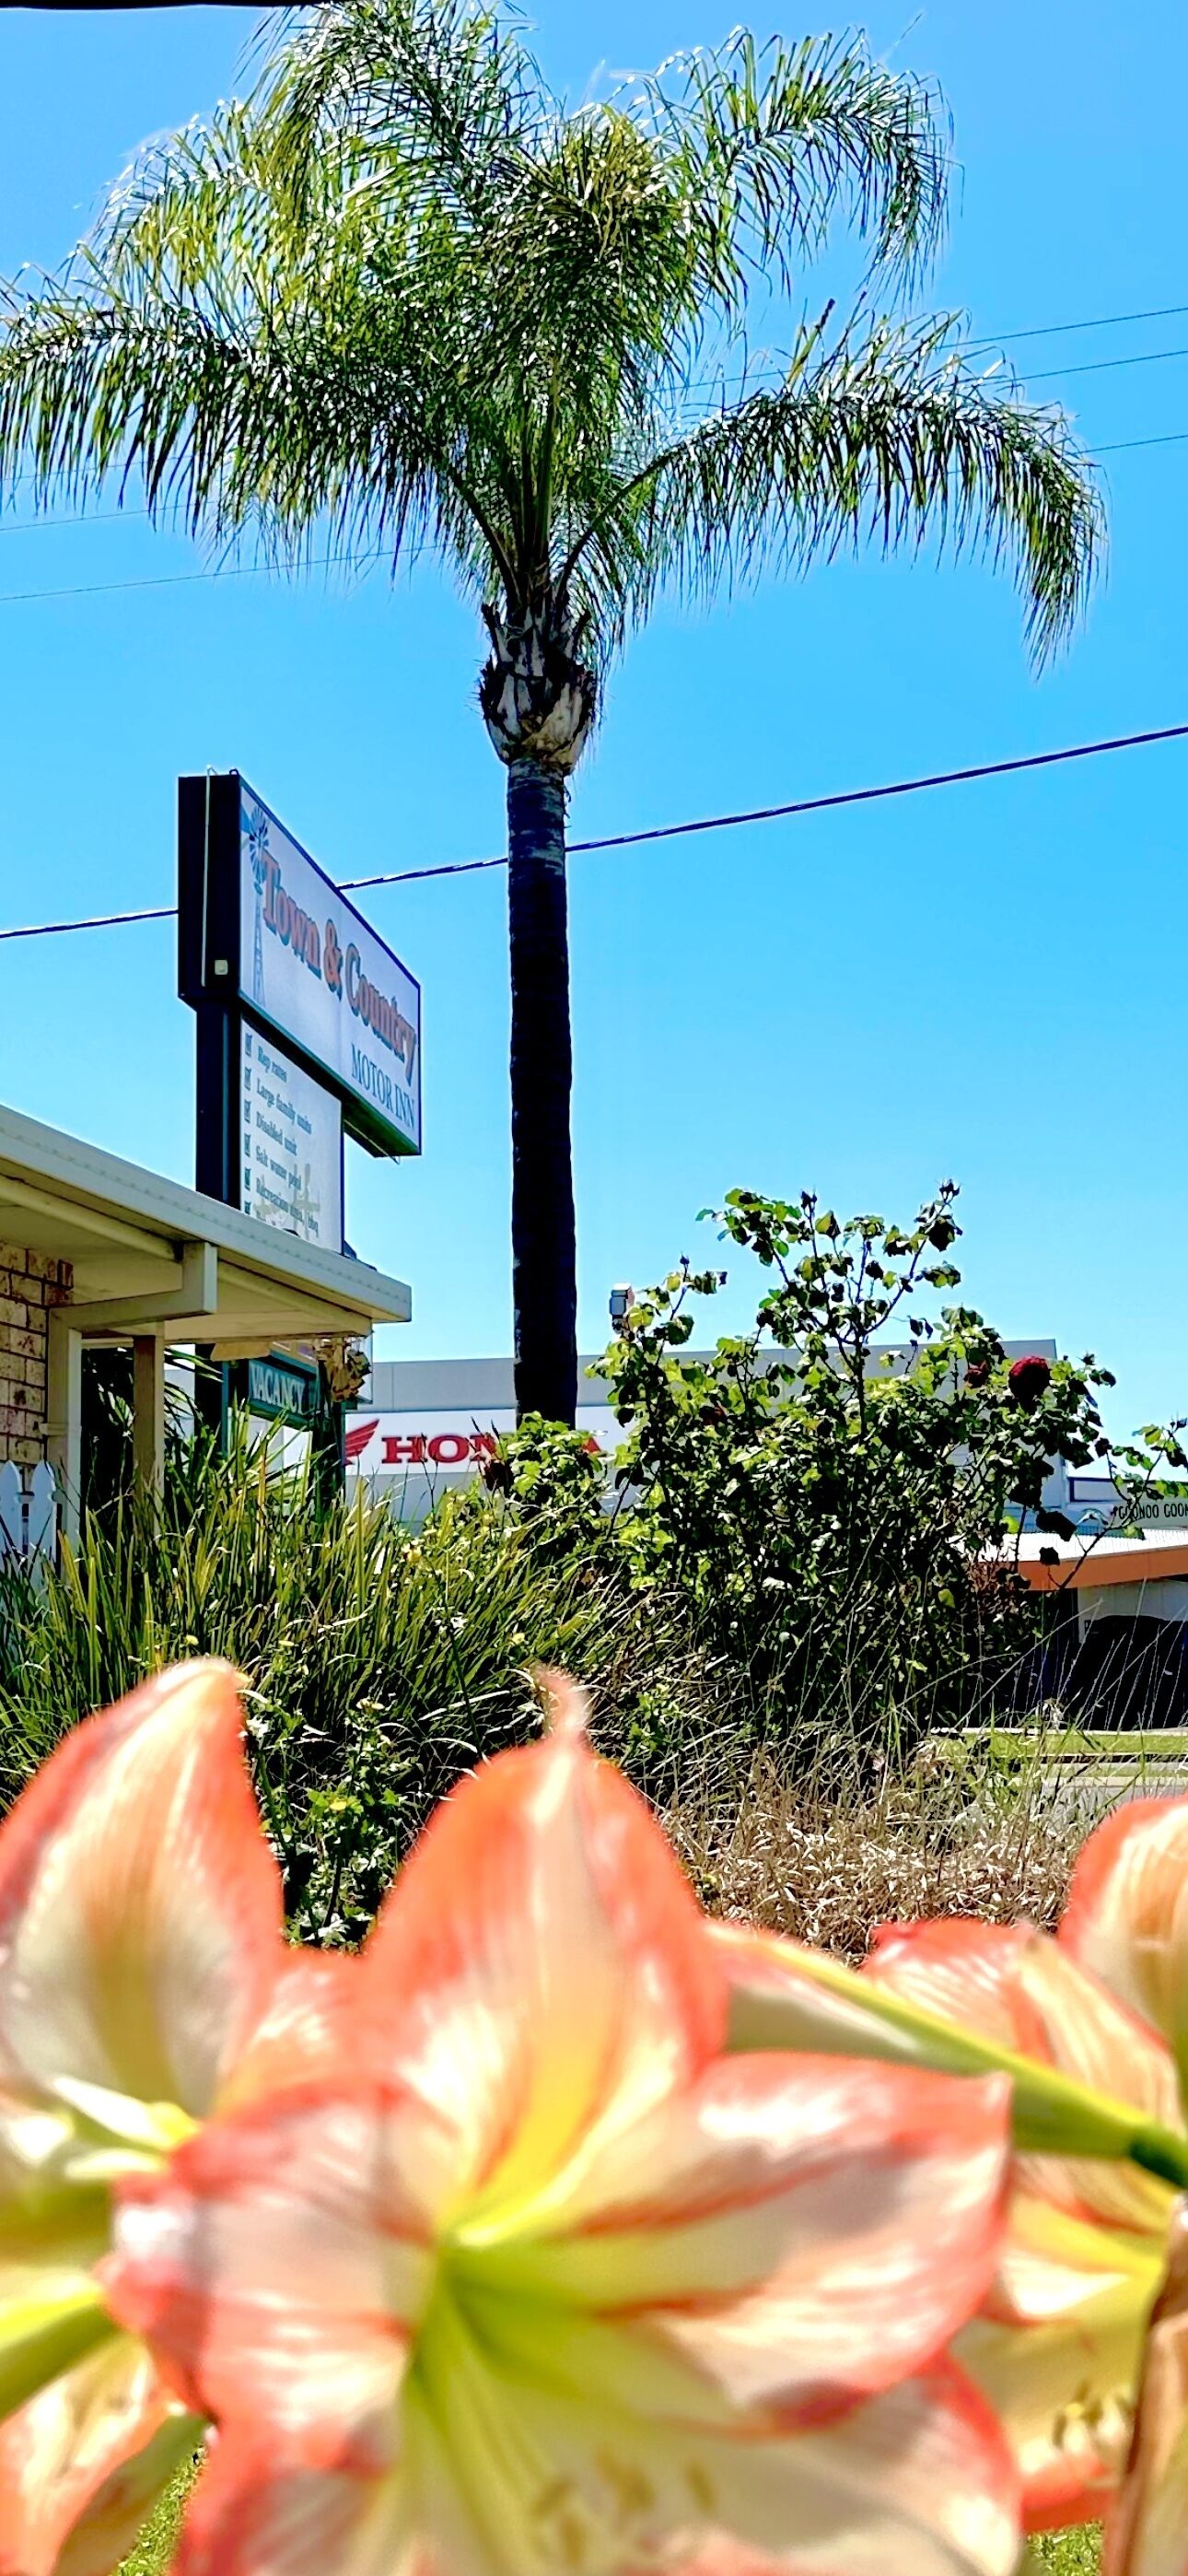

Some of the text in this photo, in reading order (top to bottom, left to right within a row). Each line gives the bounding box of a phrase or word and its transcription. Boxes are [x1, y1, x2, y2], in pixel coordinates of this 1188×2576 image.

[262, 849, 416, 1087] Town & Country
[257, 1077, 312, 1135] Large family units
[352, 1042, 414, 1130] MOTOR INN
[256, 1111, 297, 1156] Disabled unit
[256, 1145, 301, 1191] Salt water pool
[250, 1364, 307, 1415] VACANCY
